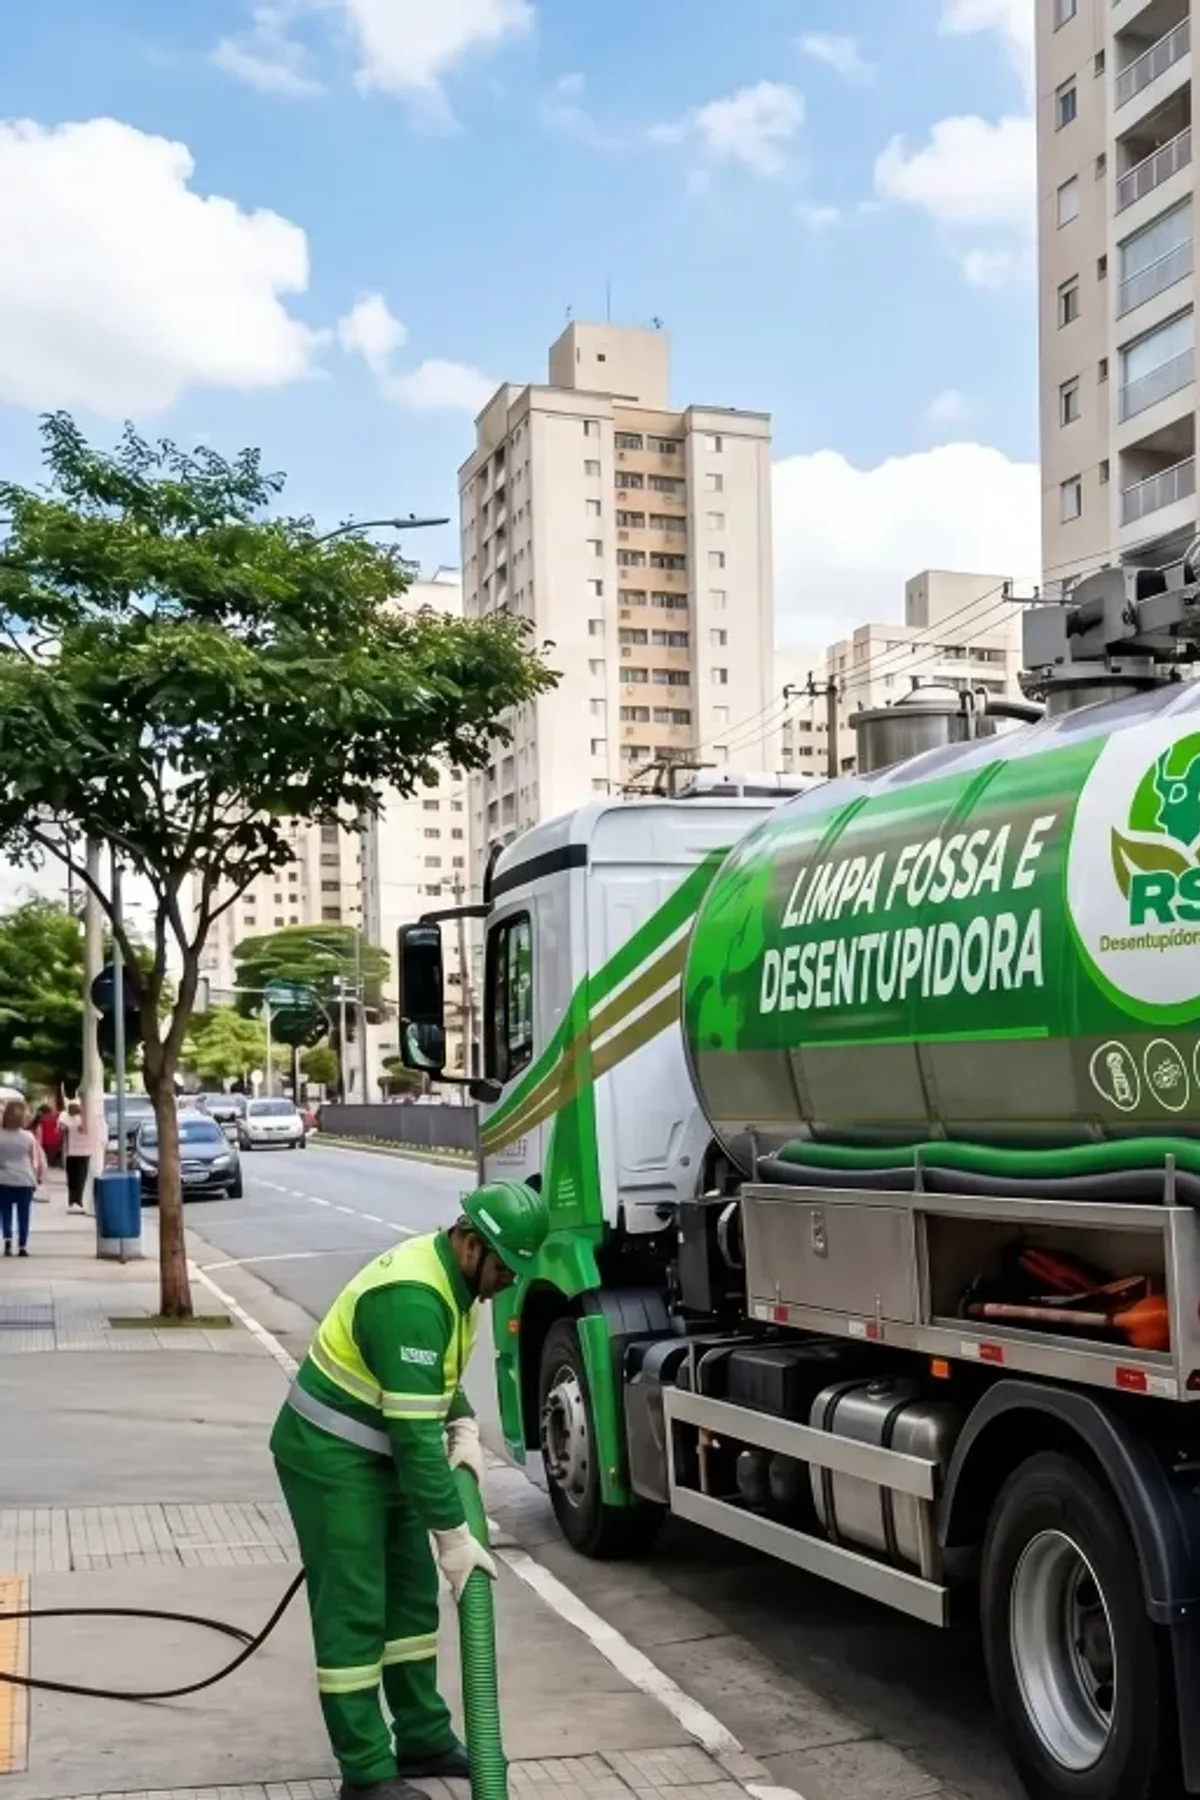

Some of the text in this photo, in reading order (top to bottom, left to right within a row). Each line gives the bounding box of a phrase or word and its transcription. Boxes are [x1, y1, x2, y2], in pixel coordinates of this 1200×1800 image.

[781, 814, 1058, 929] LIMPA FOSSA E
[760, 908, 1044, 1014] DESENTUPIDORA
